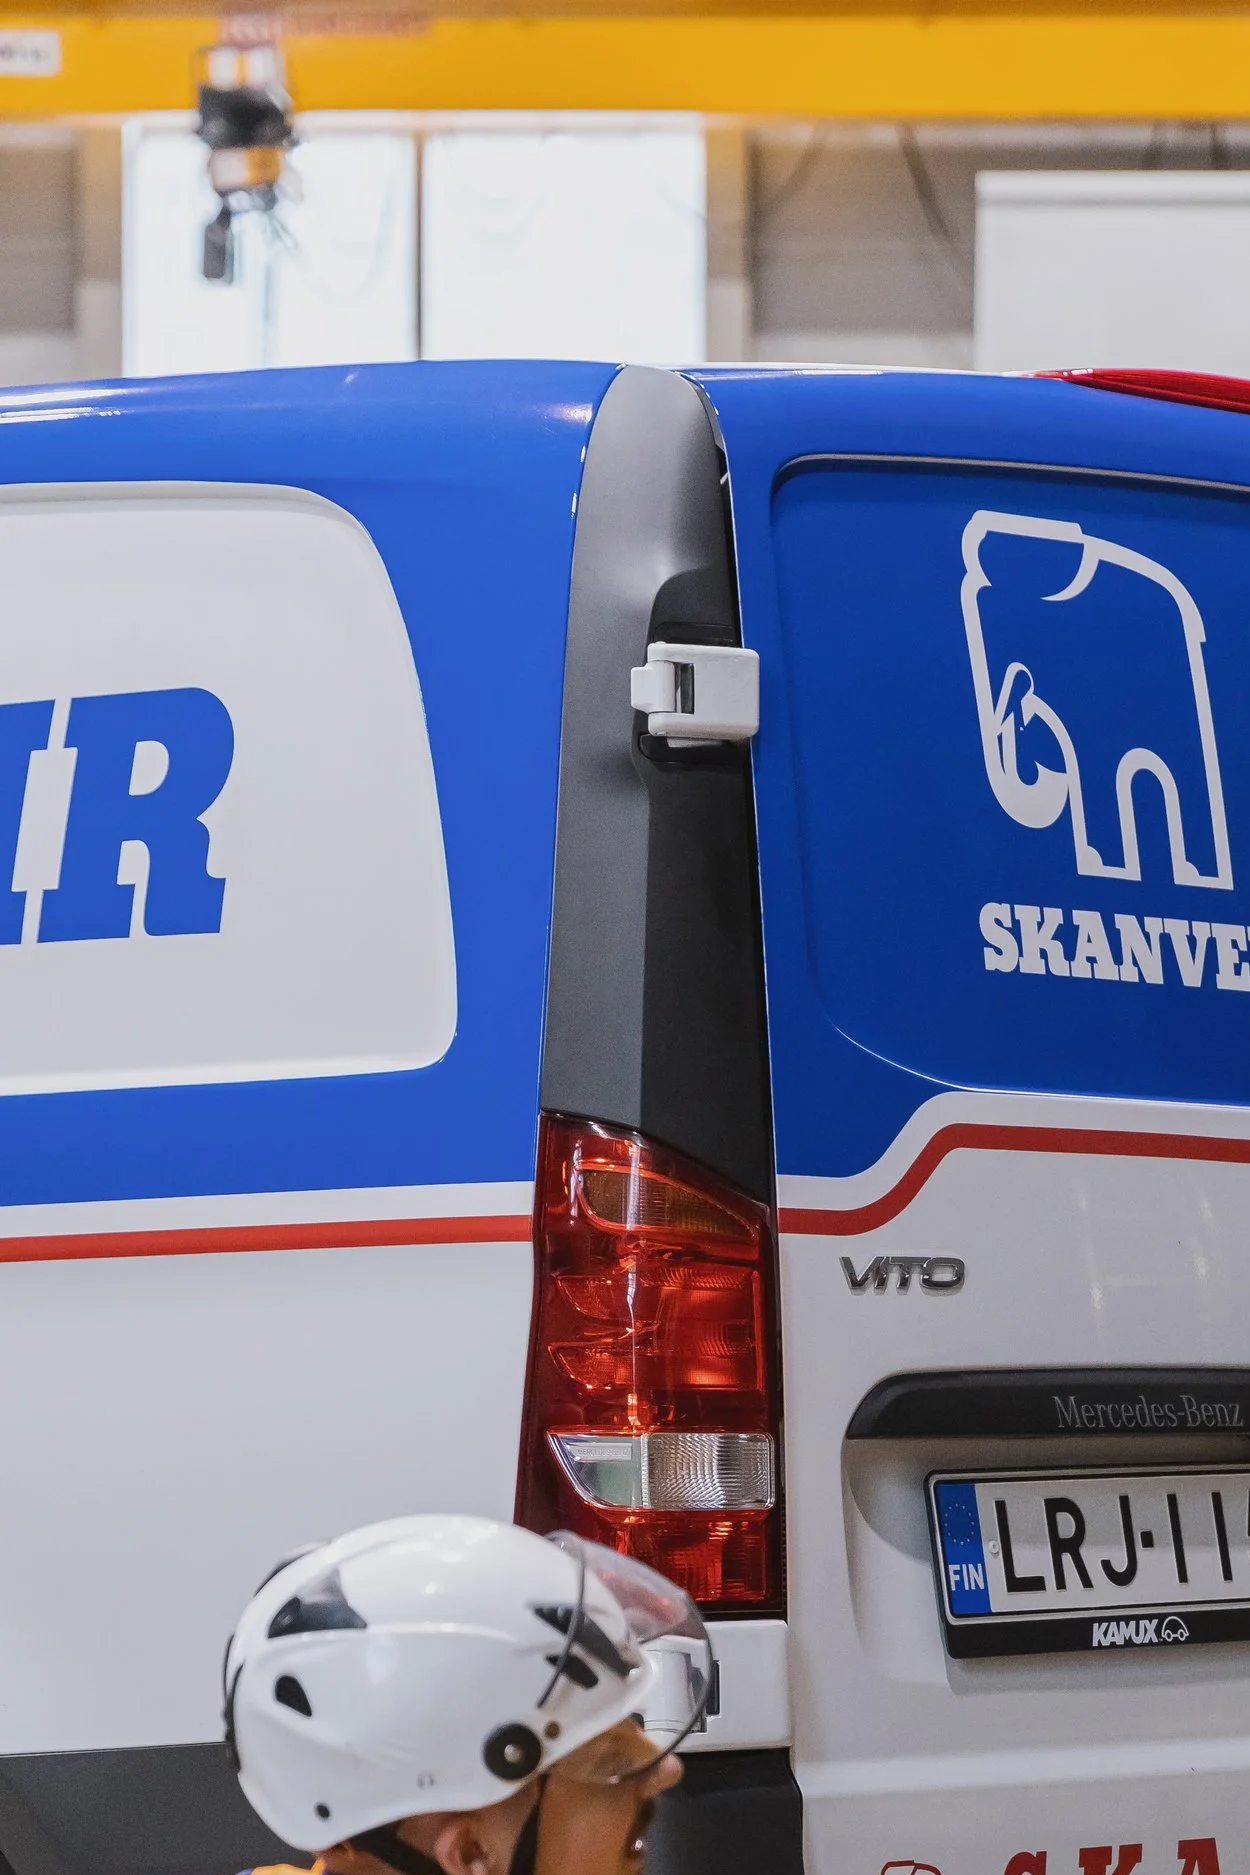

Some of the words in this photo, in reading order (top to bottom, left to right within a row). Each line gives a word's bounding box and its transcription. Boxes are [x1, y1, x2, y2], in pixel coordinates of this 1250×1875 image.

[838, 1255, 965, 1291] VITO
[1051, 1394, 1244, 1428] Mercedes-Benz
[948, 1563, 986, 1592] FIN
[1092, 1618, 1159, 1647] KAMUX
